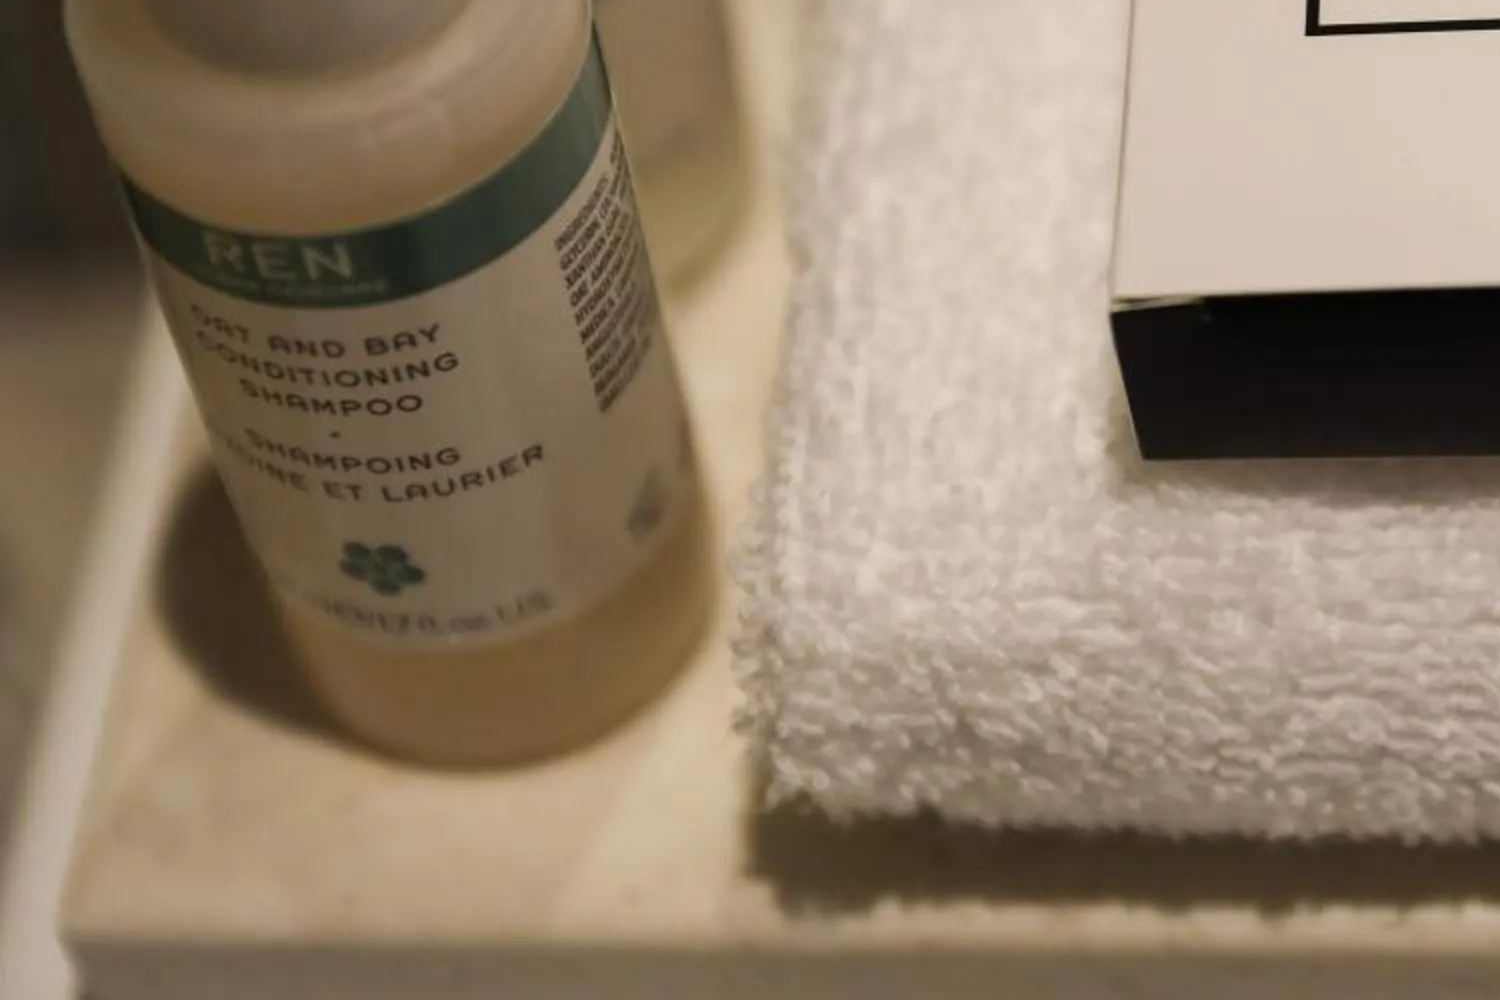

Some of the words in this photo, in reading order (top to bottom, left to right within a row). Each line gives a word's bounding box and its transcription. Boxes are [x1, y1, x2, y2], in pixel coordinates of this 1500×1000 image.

[201, 231, 354, 282] REN
[267, 335, 346, 359] AND
[364, 323, 440, 357] BAY
[238, 377, 423, 417] SHAMPOO
[244, 427, 462, 474] SHAMPOING
[323, 480, 363, 501] ET
[381, 443, 545, 503] LAURIER
